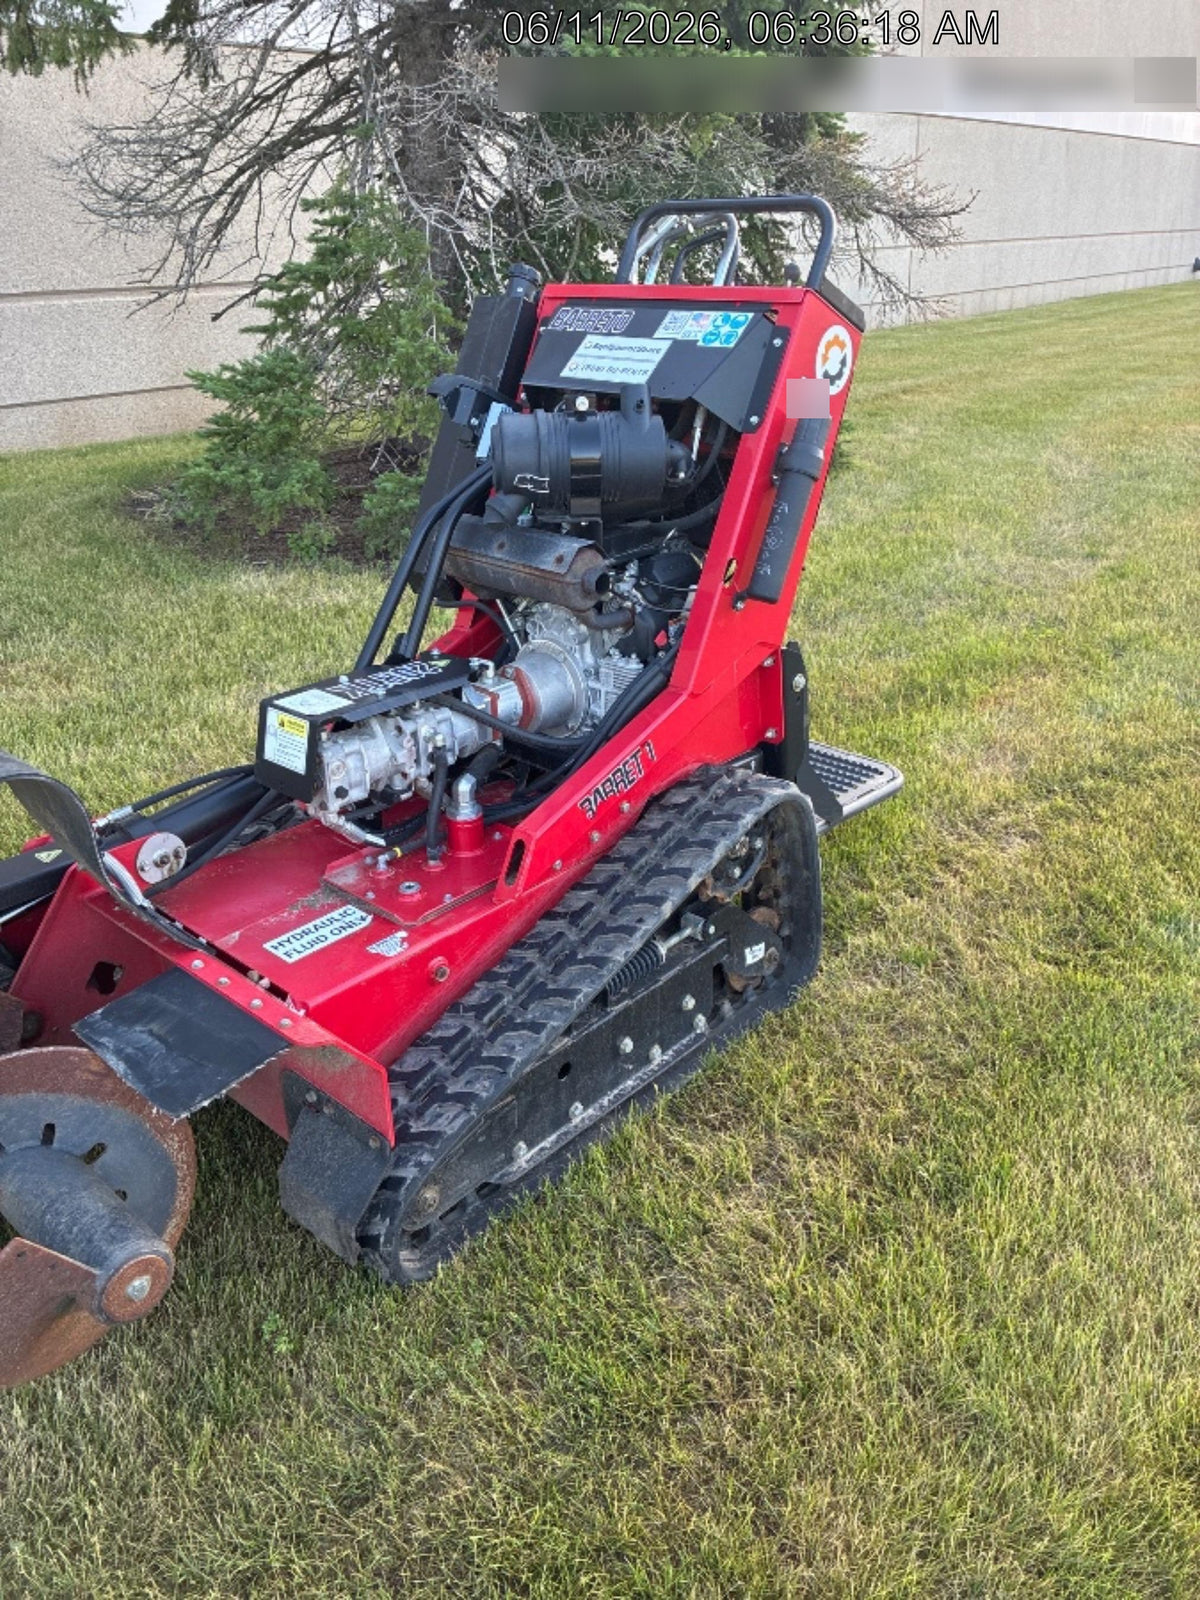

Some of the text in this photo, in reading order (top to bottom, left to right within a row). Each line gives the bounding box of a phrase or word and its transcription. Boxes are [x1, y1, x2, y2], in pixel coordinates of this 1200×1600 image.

[270, 907, 357, 951] HYDRAULIC
[283, 914, 369, 960] FLUID ONLY
